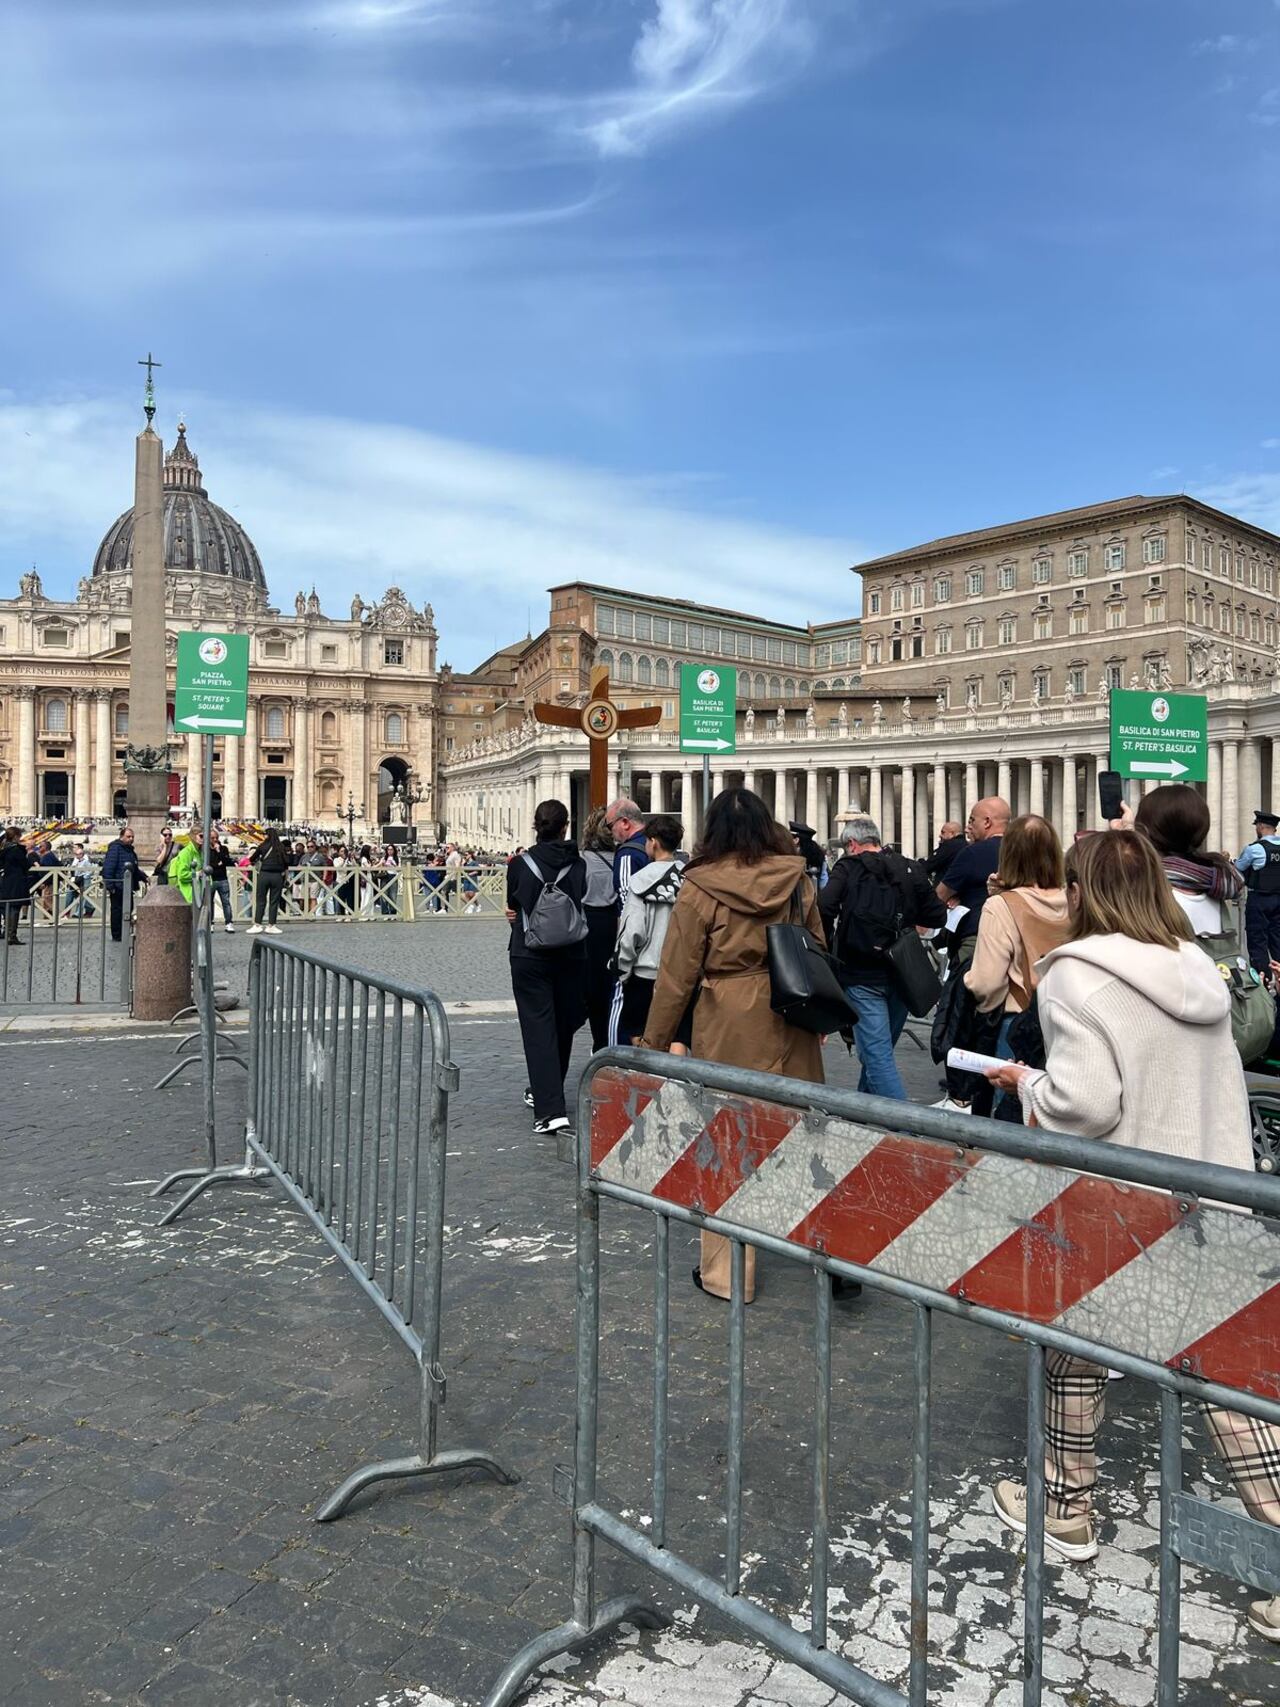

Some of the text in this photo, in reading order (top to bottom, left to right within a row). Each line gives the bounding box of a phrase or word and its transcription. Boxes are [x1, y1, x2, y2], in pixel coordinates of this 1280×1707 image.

[1119, 725, 1151, 736] BASILICA
[1161, 728, 1174, 737] SAN
[1176, 729, 1200, 738] PIETRO
[1122, 741, 1197, 754] ST. PETER'S BASILICA
